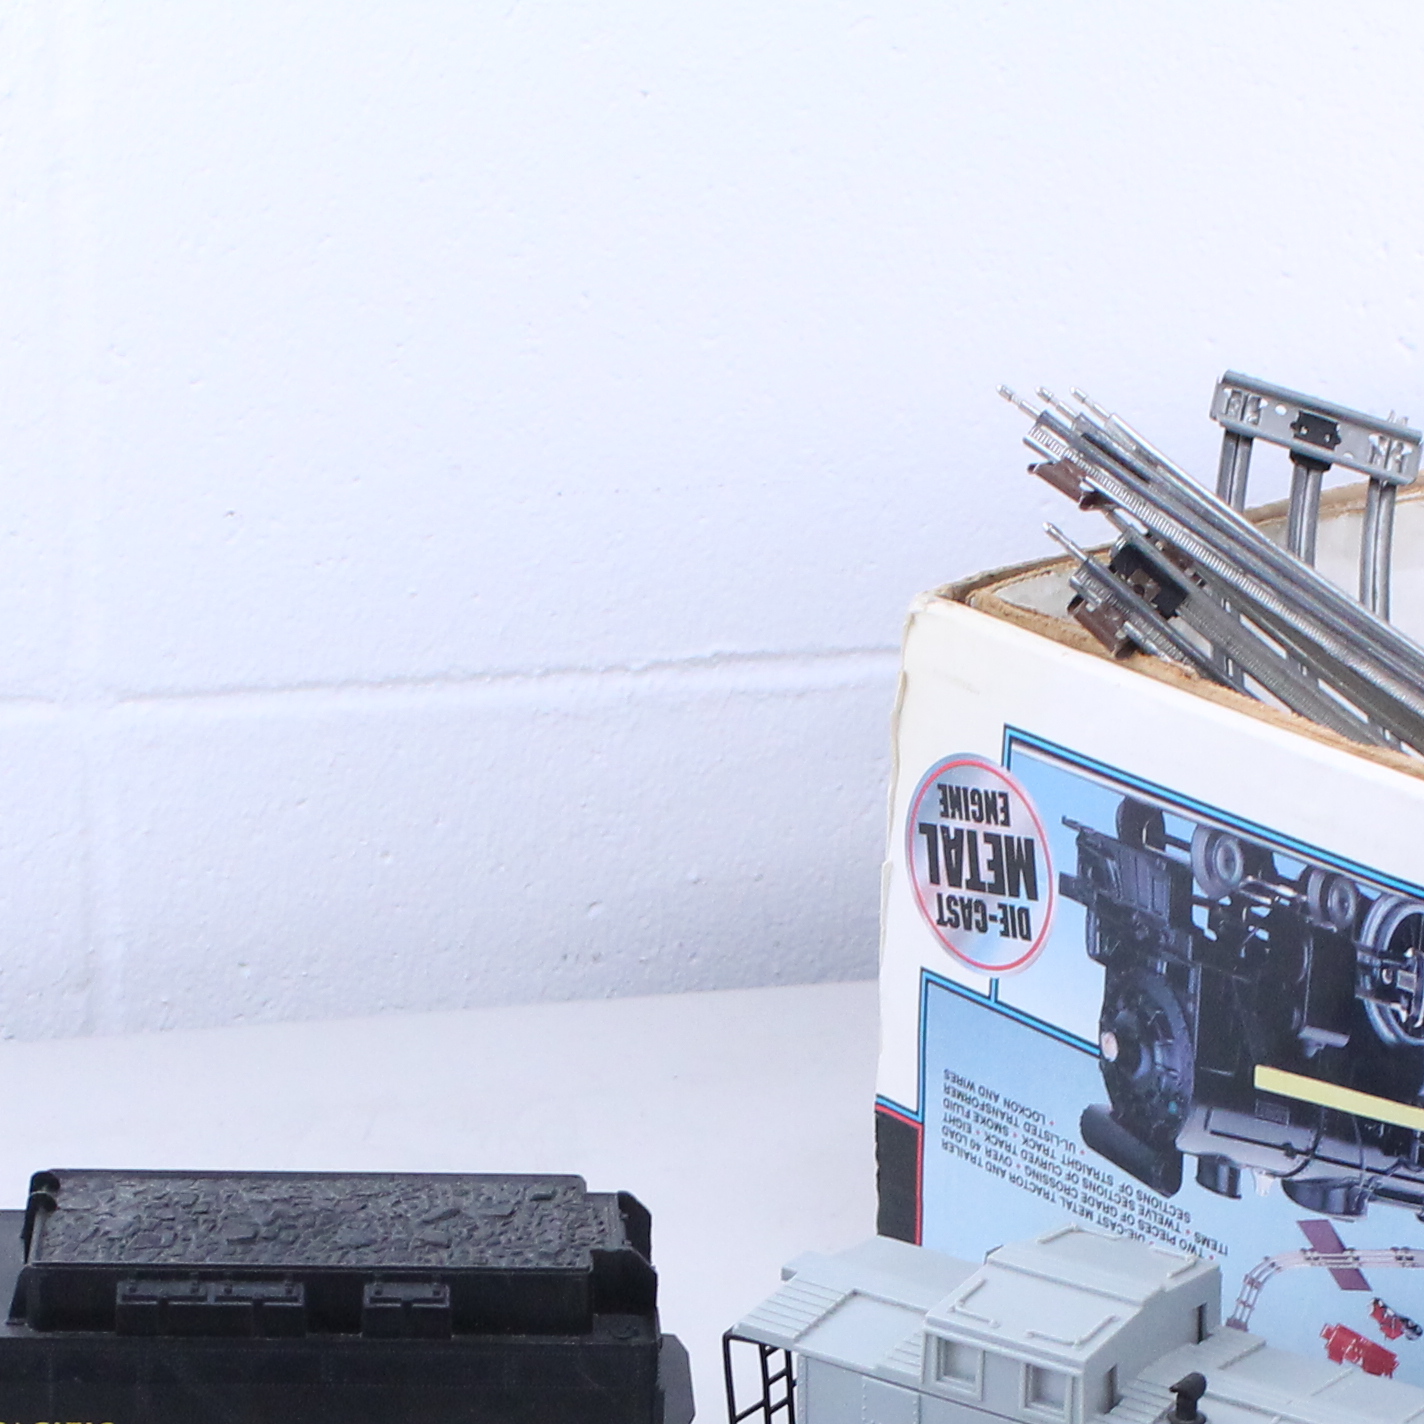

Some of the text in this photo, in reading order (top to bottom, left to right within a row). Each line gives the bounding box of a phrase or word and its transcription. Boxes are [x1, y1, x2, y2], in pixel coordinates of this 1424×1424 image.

[936, 783, 1011, 827] ENGINE
[918, 822, 1039, 901] METAL
[936, 893, 1032, 942] DIE-CAST
[942, 1082, 1020, 1129] TRANSFORMER
[943, 1069, 1046, 1126] LOCKON AND WIRES
[942, 1125, 968, 1146] LOAD
[942, 1138, 983, 1168] TRAILER
[942, 1097, 1192, 1224] SECTIONS OF STRAIGHT TRACK SMOKE FLUID
[984, 1146, 1013, 1168] OVER
[942, 1112, 1229, 1257] ITEMS TWELVE SECTIONS OF CURVED TRACK EIGHT
[984, 1161, 1007, 1179] AND
[1024, 1164, 1079, 1200] CROSSING
[1007, 1171, 1056, 1204] TRACTOR
[1059, 1196, 1093, 1222] METAL
[1080, 1191, 1119, 1218] GRADE
[1121, 1212, 1135, 1226] OF
[1137, 1219, 1176, 1246] PIECES
[1179, 1239, 1205, 1259] TWO
